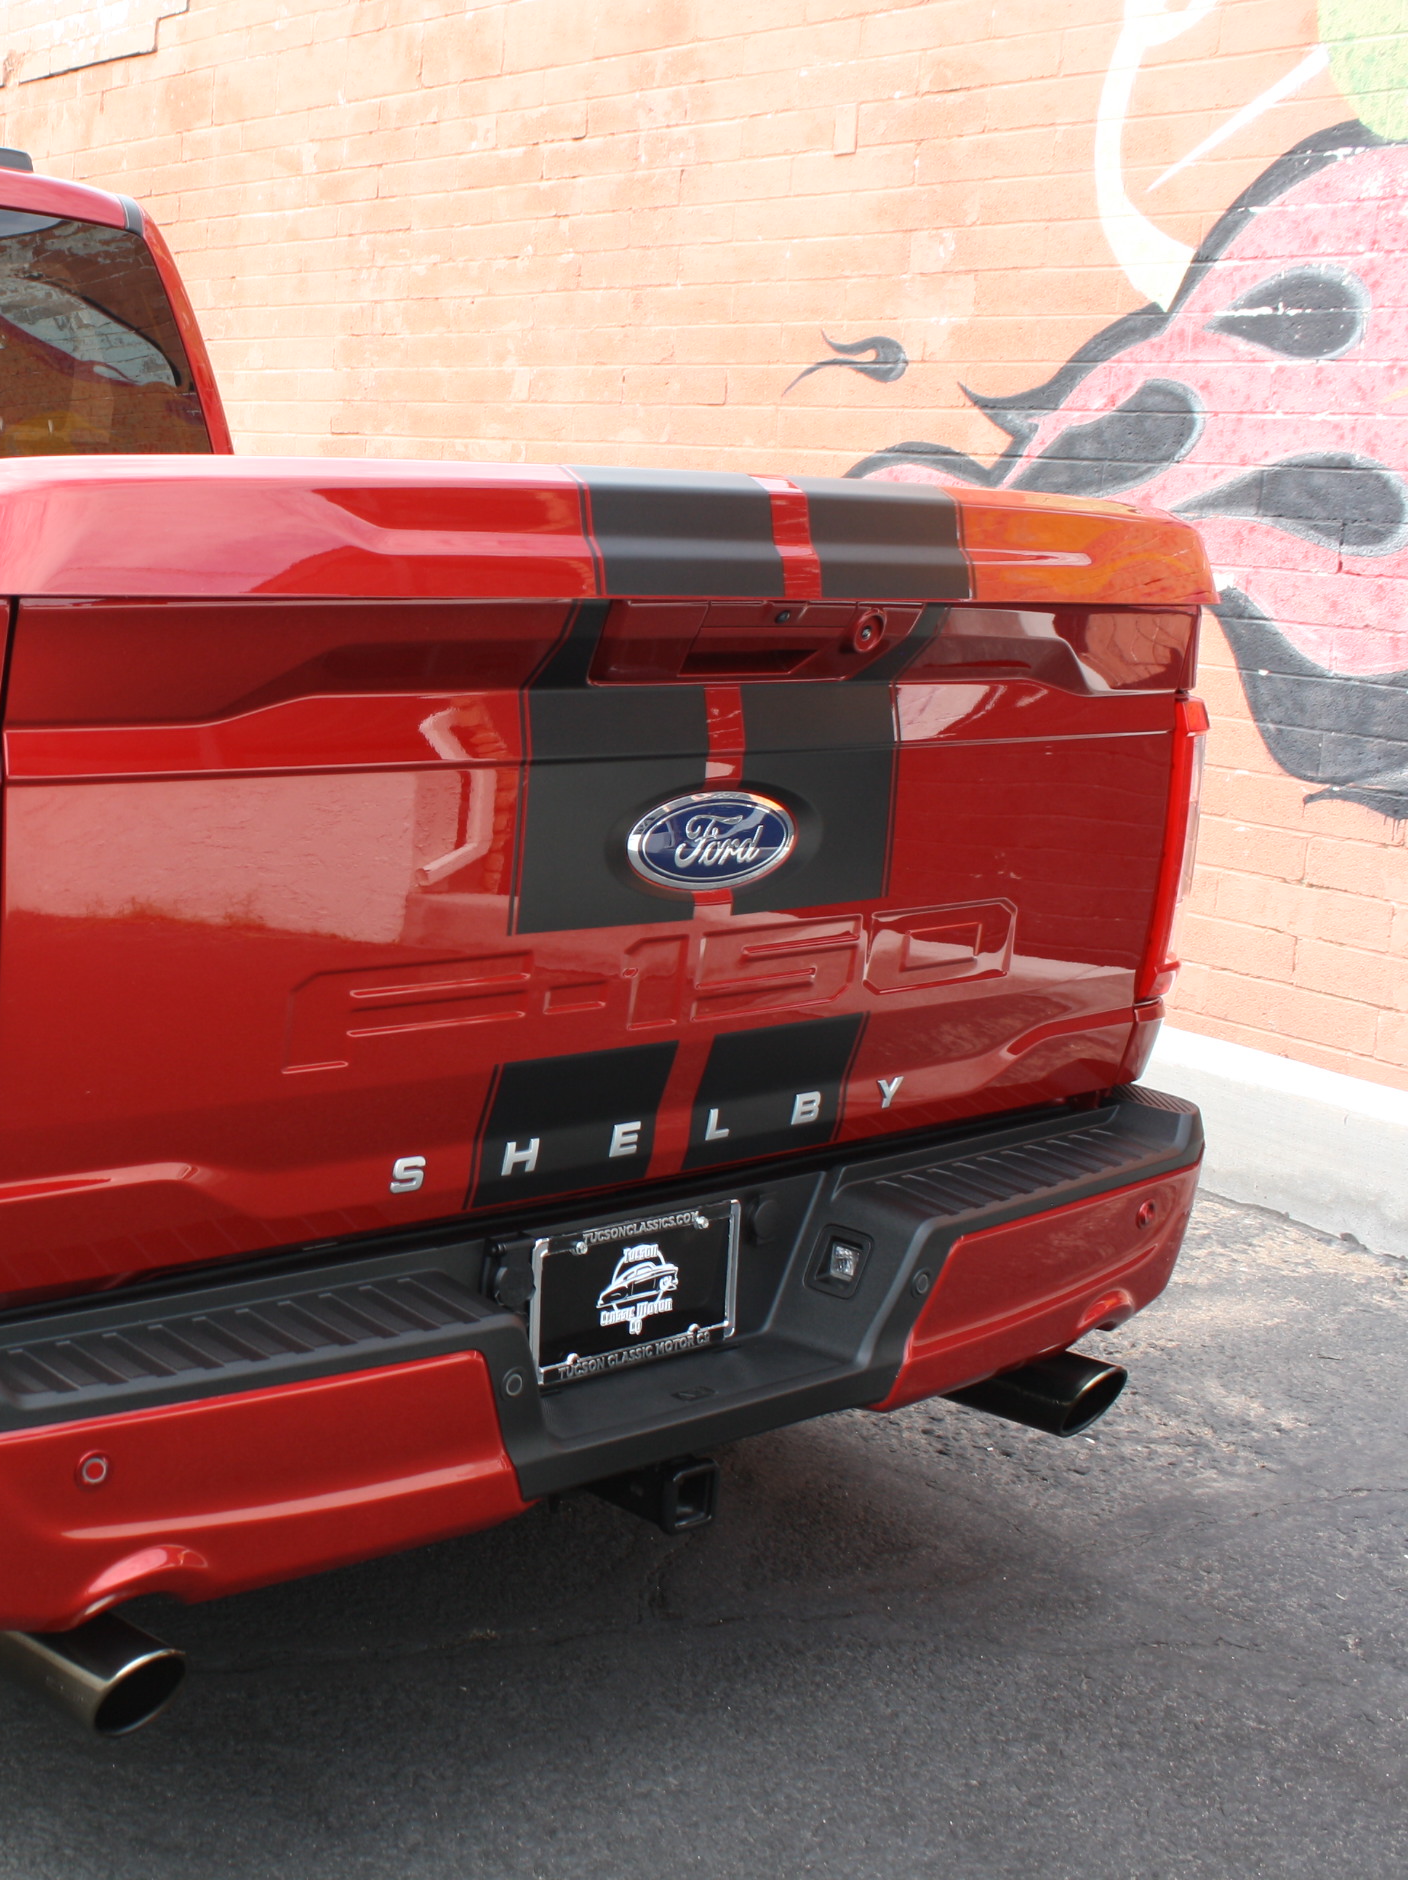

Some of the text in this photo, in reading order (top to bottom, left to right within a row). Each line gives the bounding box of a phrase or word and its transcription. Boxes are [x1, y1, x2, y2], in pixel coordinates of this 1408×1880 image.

[674, 814, 764, 869] Ford
[281, 897, 1018, 1074] F-150
[390, 1077, 904, 1193] SHELBY
[558, 1357, 605, 1380] TUCSON
[607, 1345, 653, 1367] CLASSIC
[655, 1334, 695, 1355] MOTOR
